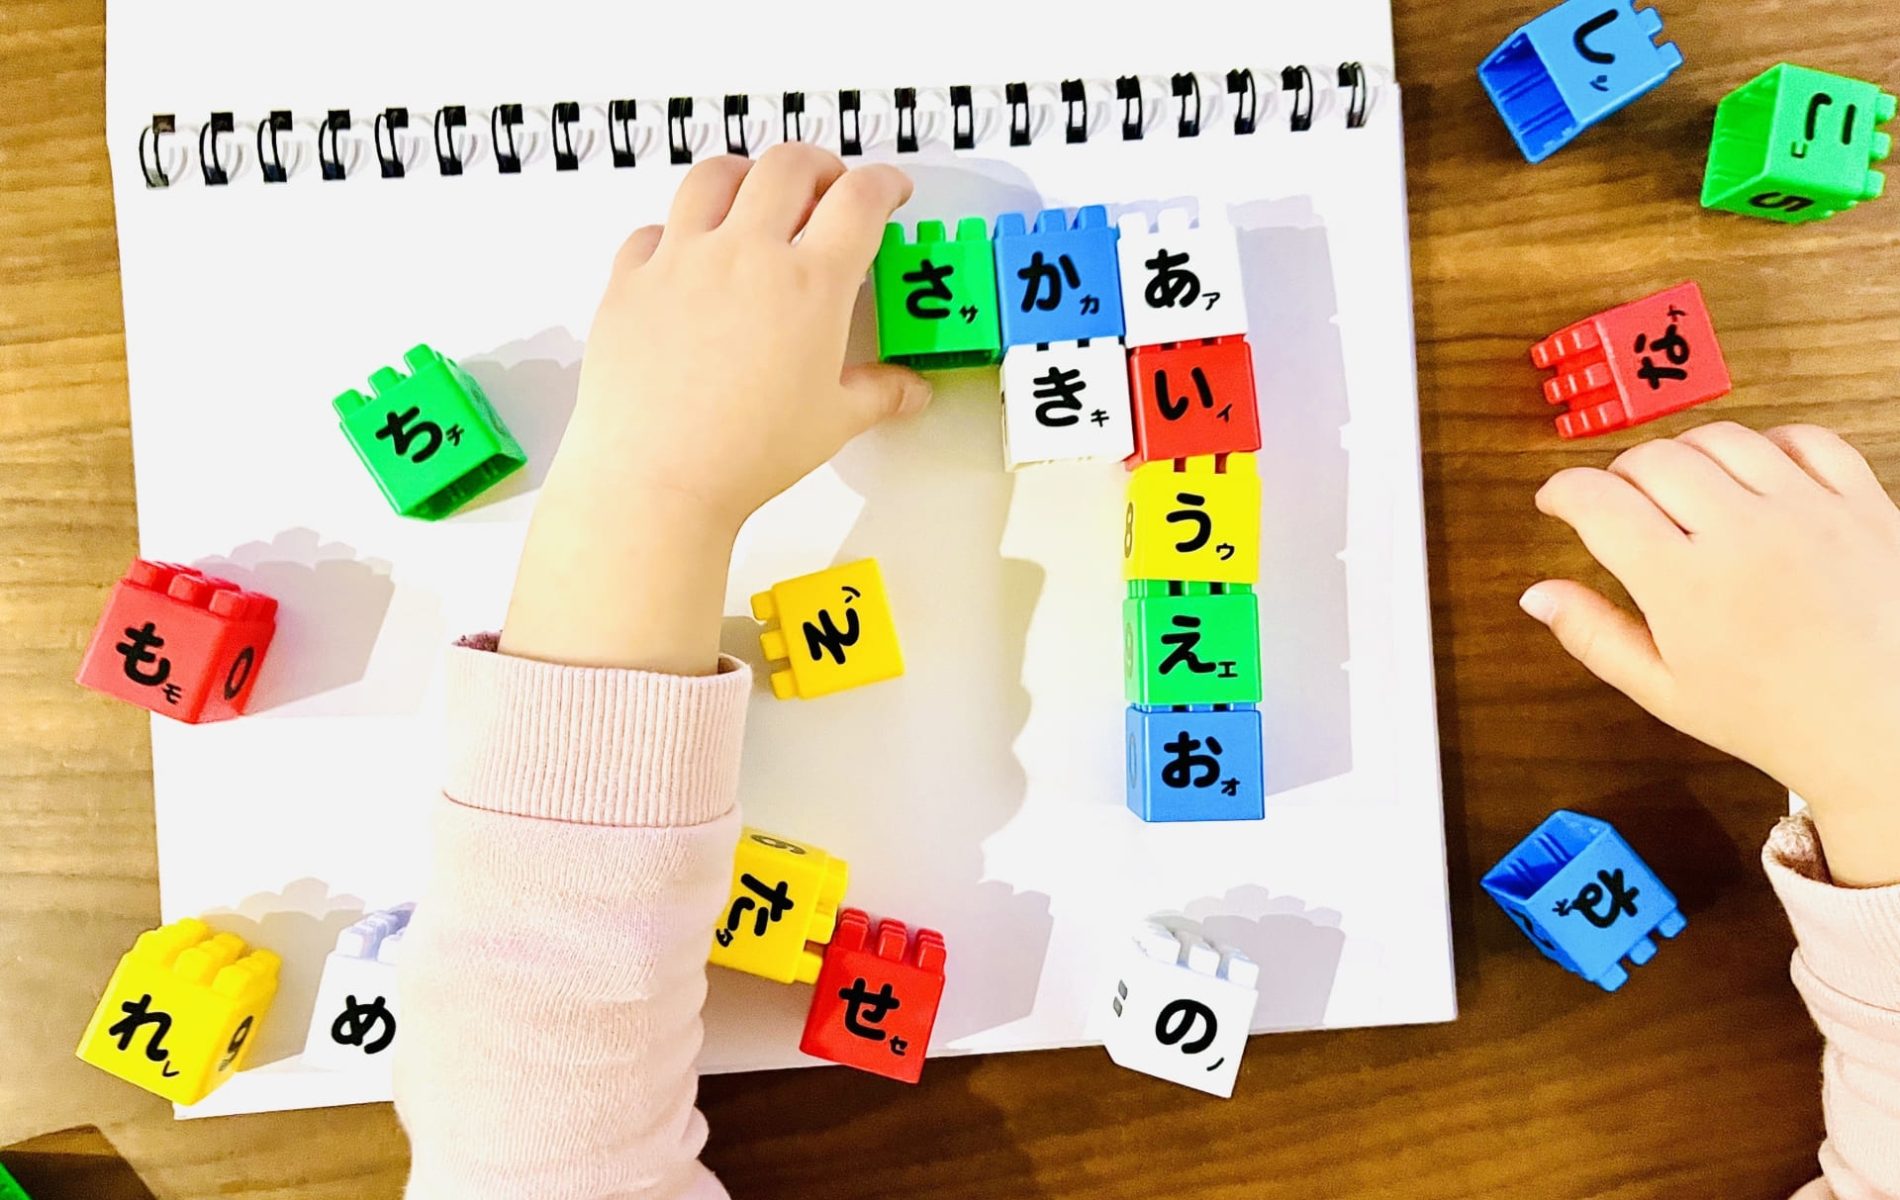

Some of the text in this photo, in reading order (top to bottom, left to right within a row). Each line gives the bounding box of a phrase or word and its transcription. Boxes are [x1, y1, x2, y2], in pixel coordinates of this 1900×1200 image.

[1573, 8, 1619, 65] し
[901, 258, 980, 324] さ サ
[1016, 251, 1101, 316] か カ
[1144, 248, 1221, 311] あ ア
[1634, 323, 1690, 390] な
[1032, 366, 1087, 428] き
[1090, 408, 1110, 428] キ
[1154, 366, 1233, 423] い イ
[374, 405, 443, 463] ち
[446, 423, 465, 447] チ
[1165, 492, 1212, 553] う
[115, 622, 171, 686] も
[802, 607, 860, 665] そ
[1158, 614, 1217, 675] え
[1161, 730, 1223, 789] お
[728, 873, 795, 937] た
[1571, 867, 1640, 929] ね
[108, 993, 172, 1061] れ
[330, 994, 397, 1055] め
[838, 977, 901, 1041] せ
[1154, 998, 1218, 1055] の
